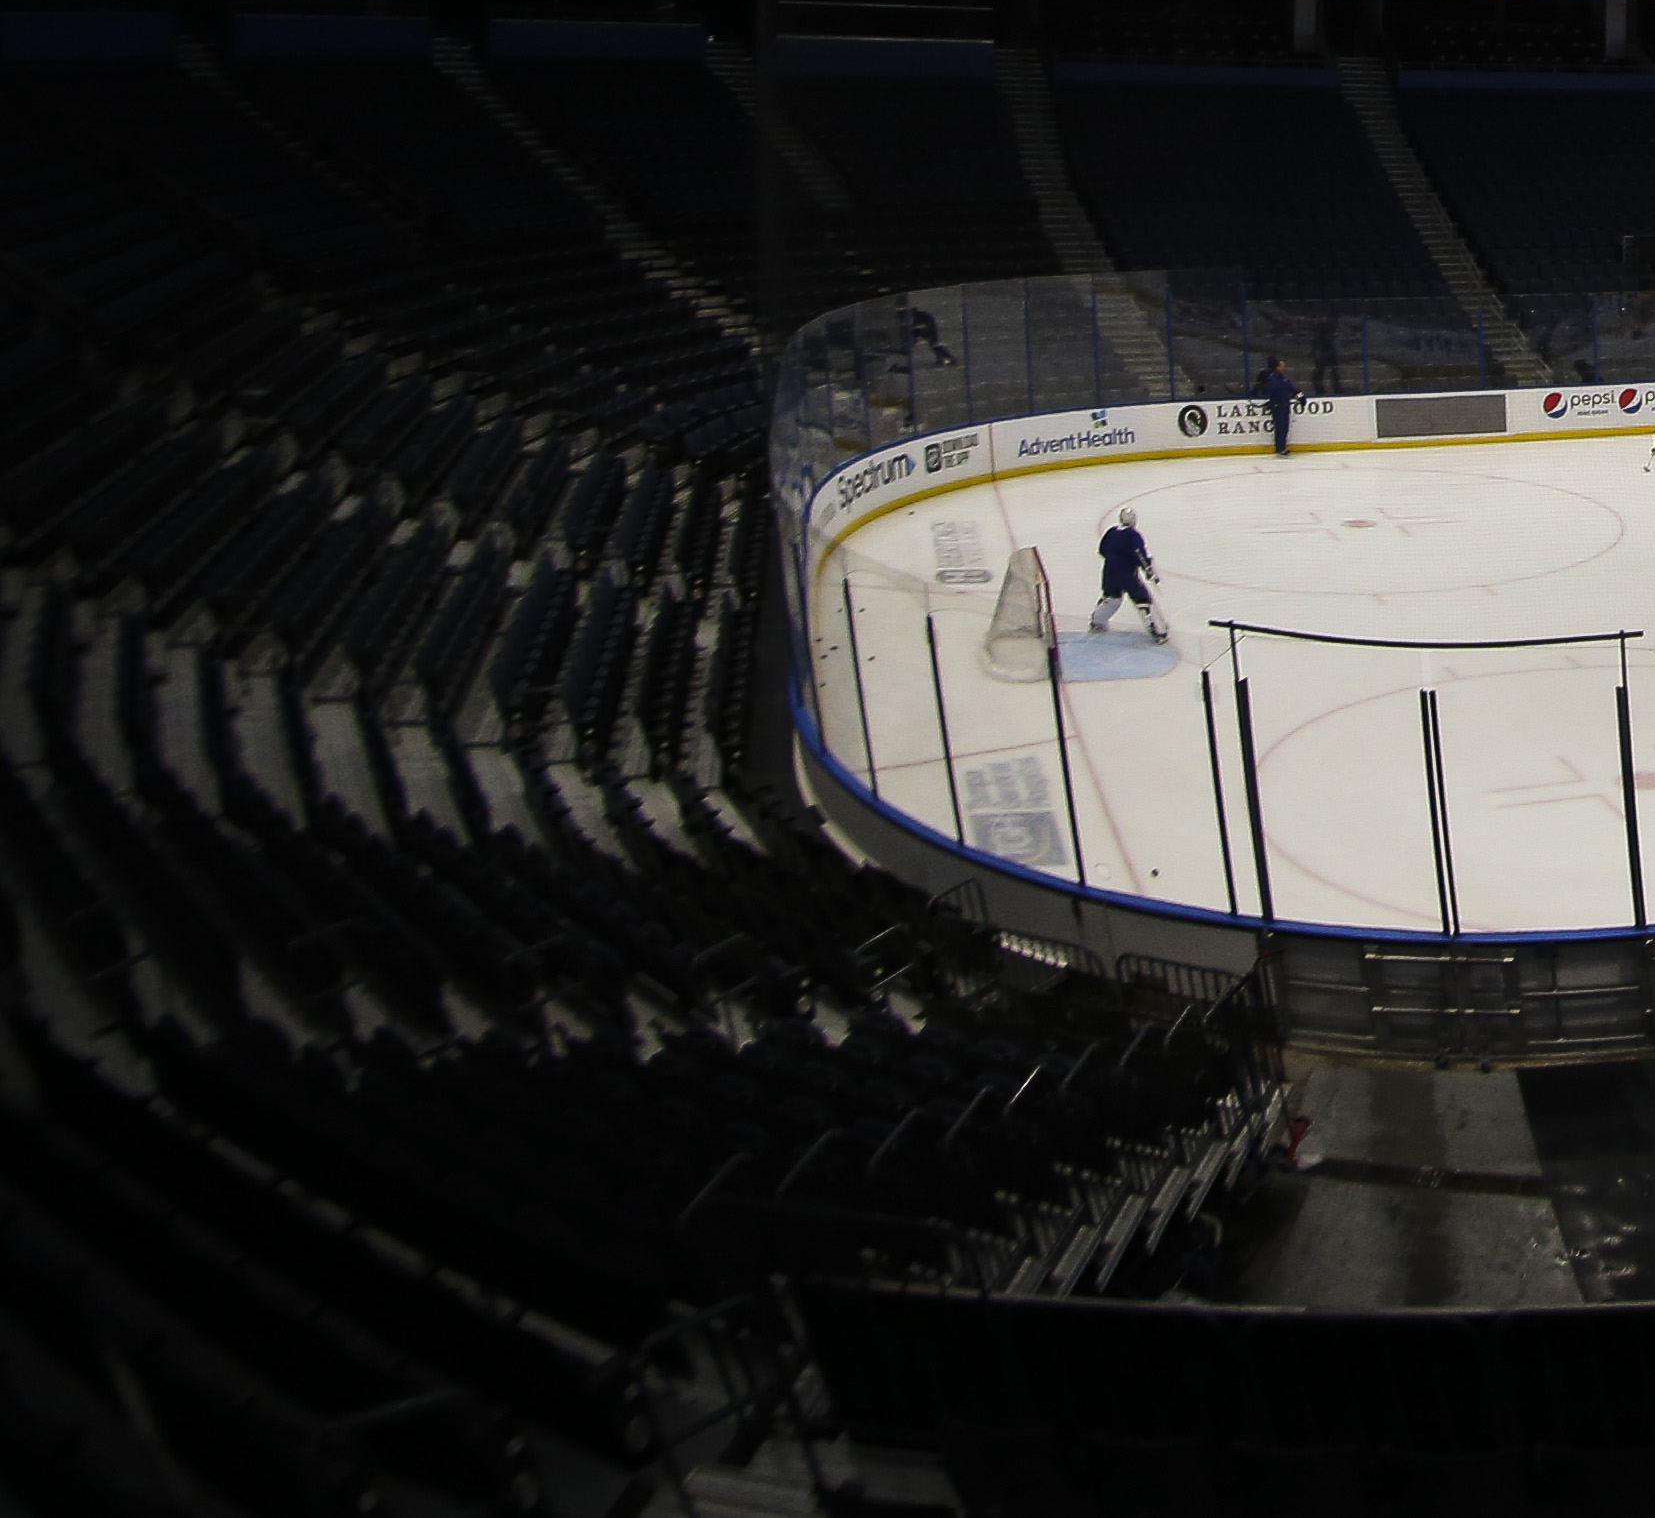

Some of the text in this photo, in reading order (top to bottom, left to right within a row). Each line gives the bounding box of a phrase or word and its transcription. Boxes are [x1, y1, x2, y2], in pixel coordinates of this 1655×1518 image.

[1570, 390, 1617, 409] pepsi
[1216, 401, 1334, 418] LAKEOOD
[1217, 420, 1276, 435] RANC
[1018, 426, 1136, 458] AdventHealth
[837, 453, 909, 511] Spectrum
